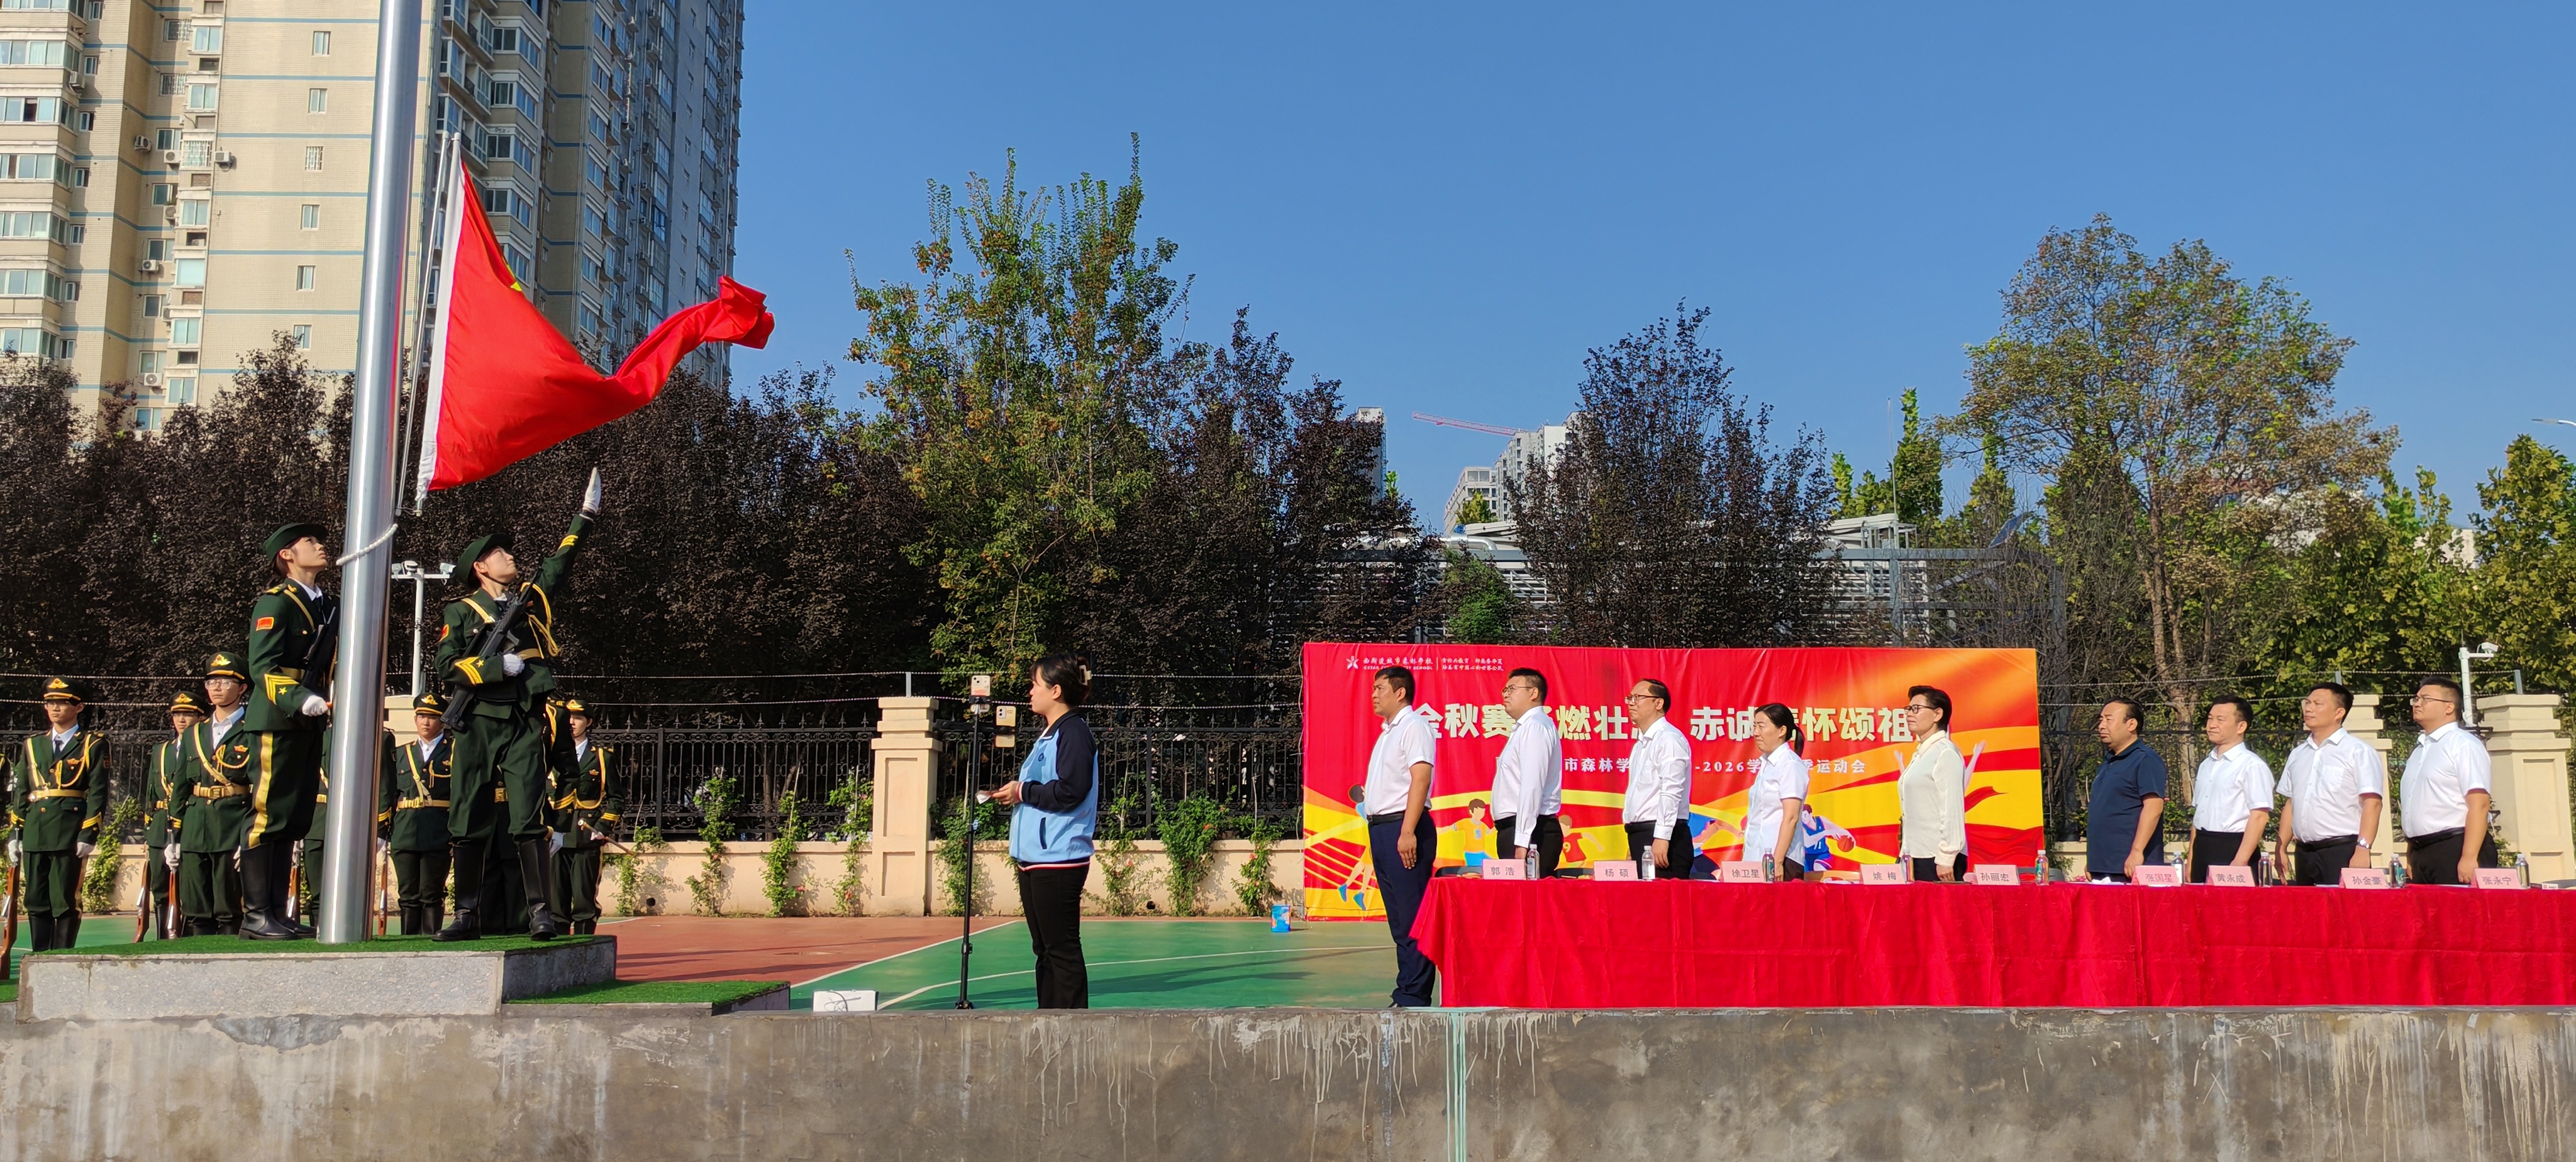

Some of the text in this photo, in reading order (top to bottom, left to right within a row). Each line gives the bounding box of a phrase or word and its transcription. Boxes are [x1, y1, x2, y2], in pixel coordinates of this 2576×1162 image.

[1415, 702, 1949, 742] 金秋赛燃壮 赤诚怀颂祖
[1731, 869, 1760, 878] 徐卫星
[2482, 876, 2511, 885] 张永宁
